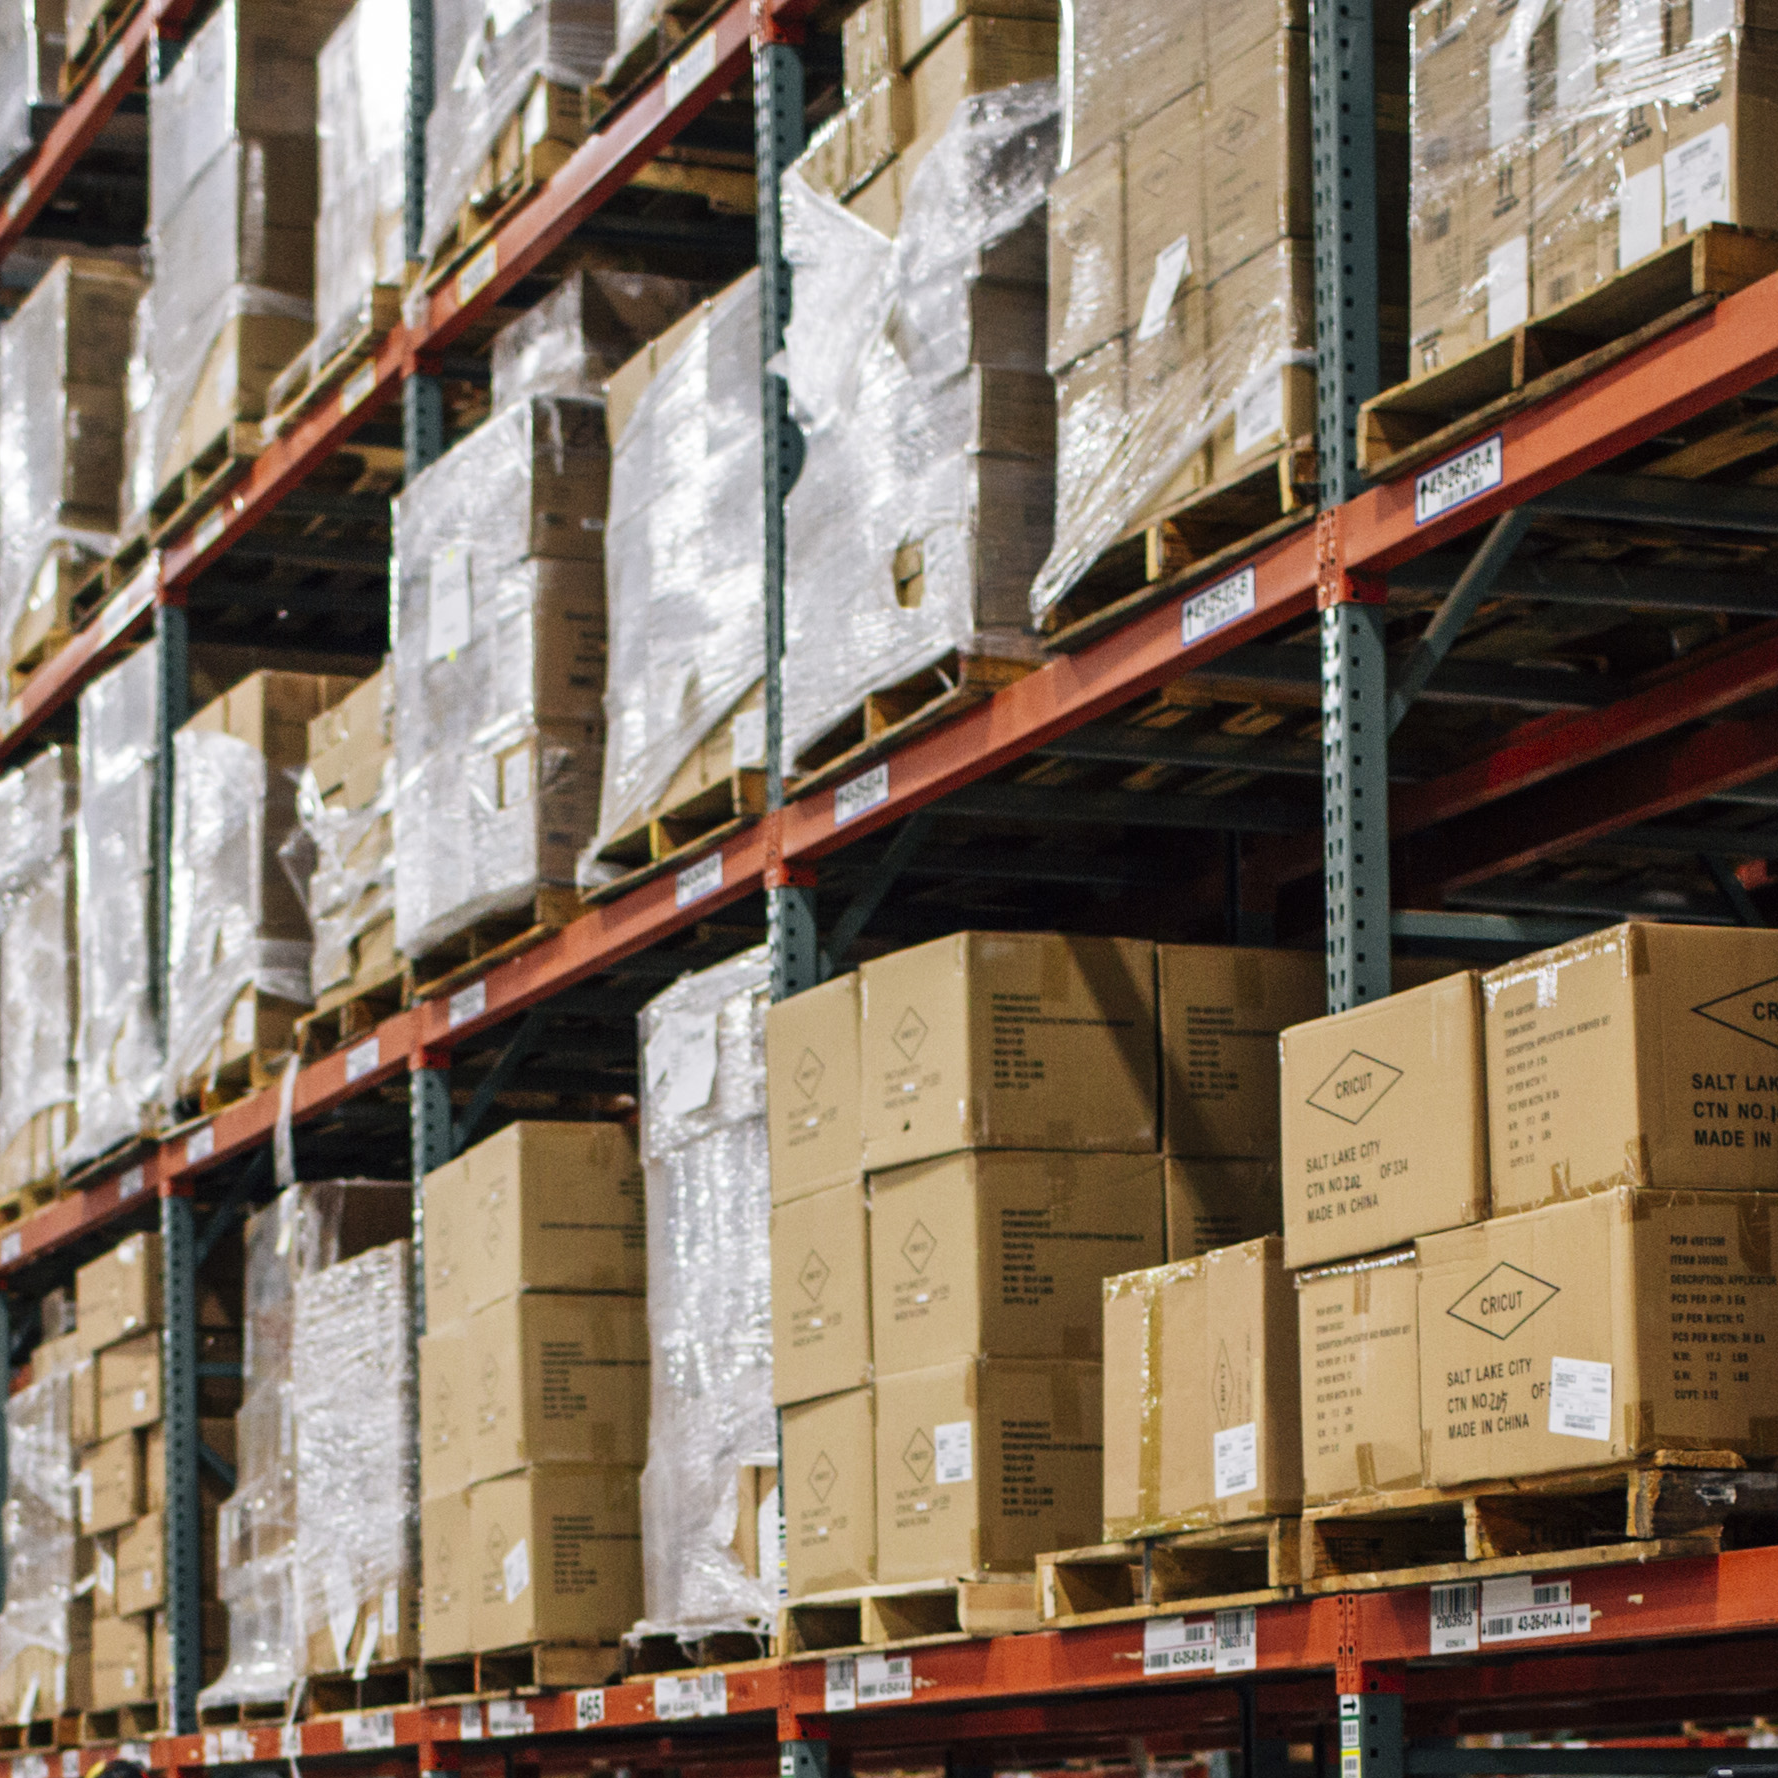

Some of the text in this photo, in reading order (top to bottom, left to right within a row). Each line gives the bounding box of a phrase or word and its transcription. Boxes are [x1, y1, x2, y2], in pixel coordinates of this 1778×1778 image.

[1335, 1072, 1372, 1099] CRICUT
[1692, 1073, 1736, 1091] SALT
[1694, 1102, 1769, 1120] CTN NO.
[1694, 1130, 1745, 1146] MADE
[1755, 1131, 1771, 1147] IN
[1306, 1139, 1381, 1173] SALT LAKE CITY
[1306, 1182, 1325, 1199] CTN
[1380, 1163, 1392, 1179] OF
[1307, 1194, 1379, 1223] MADE IN CHINA
[1728, 1275, 1777, 1286] APPLICATOR
[1481, 1291, 1523, 1315] CRICUT
[1671, 1294, 1746, 1306] PCS PER EA
[1732, 1353, 1749, 1363] LBS
[1447, 1357, 1532, 1387] SALT LAKE CITY
[1448, 1397, 1467, 1413] CTN
[1531, 1382, 1546, 1399] OF
[1449, 1413, 1530, 1439] MADE IN CHINA
[1518, 1612, 1562, 1631] 43-26-01-A
